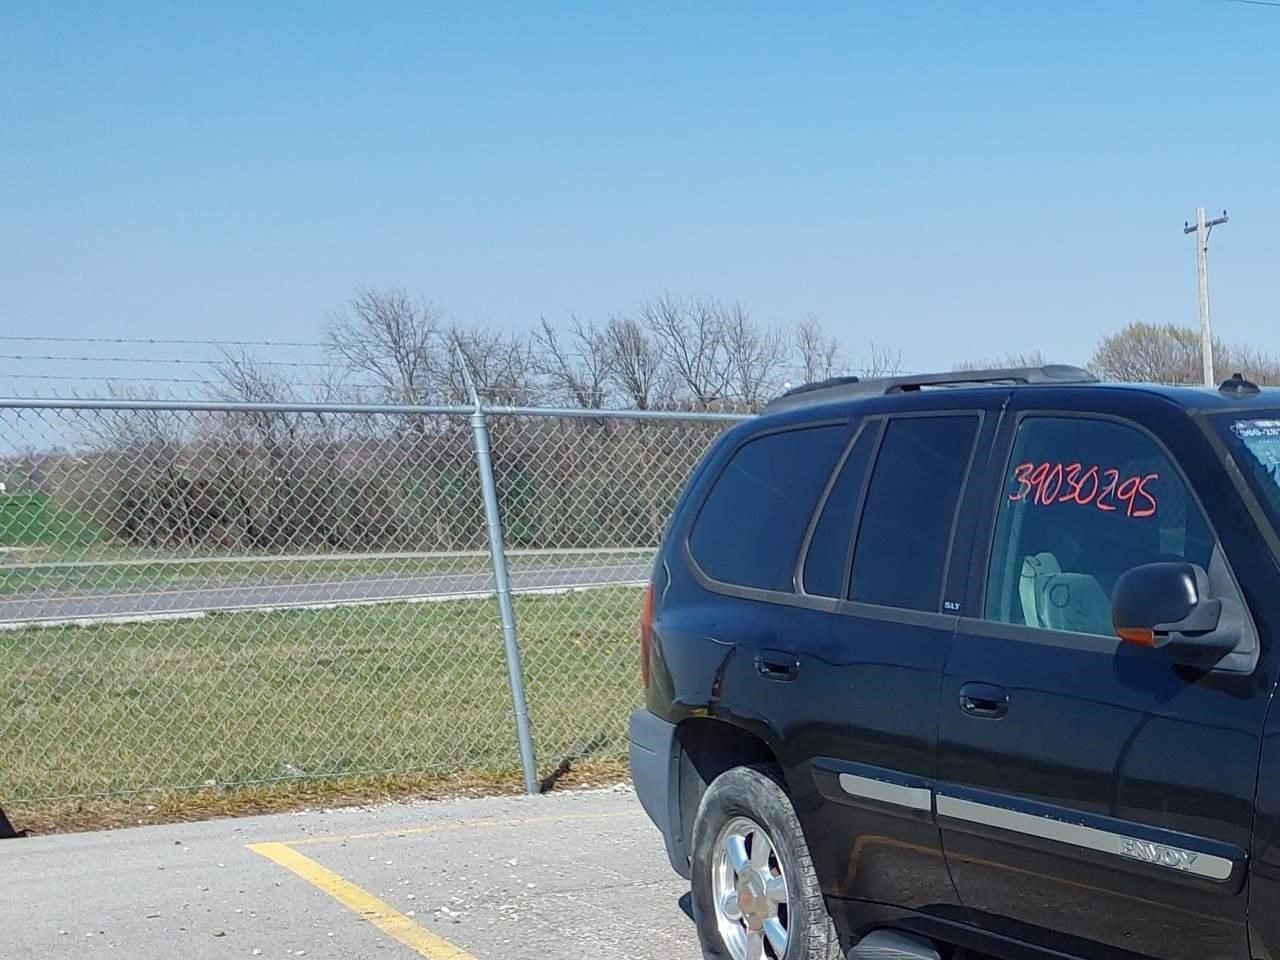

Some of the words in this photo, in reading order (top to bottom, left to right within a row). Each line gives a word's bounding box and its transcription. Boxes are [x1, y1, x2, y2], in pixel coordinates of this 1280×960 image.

[1009, 462, 1158, 517] 39030295
[944, 601, 960, 610] SLT
[1123, 840, 1198, 870] ENVOY
